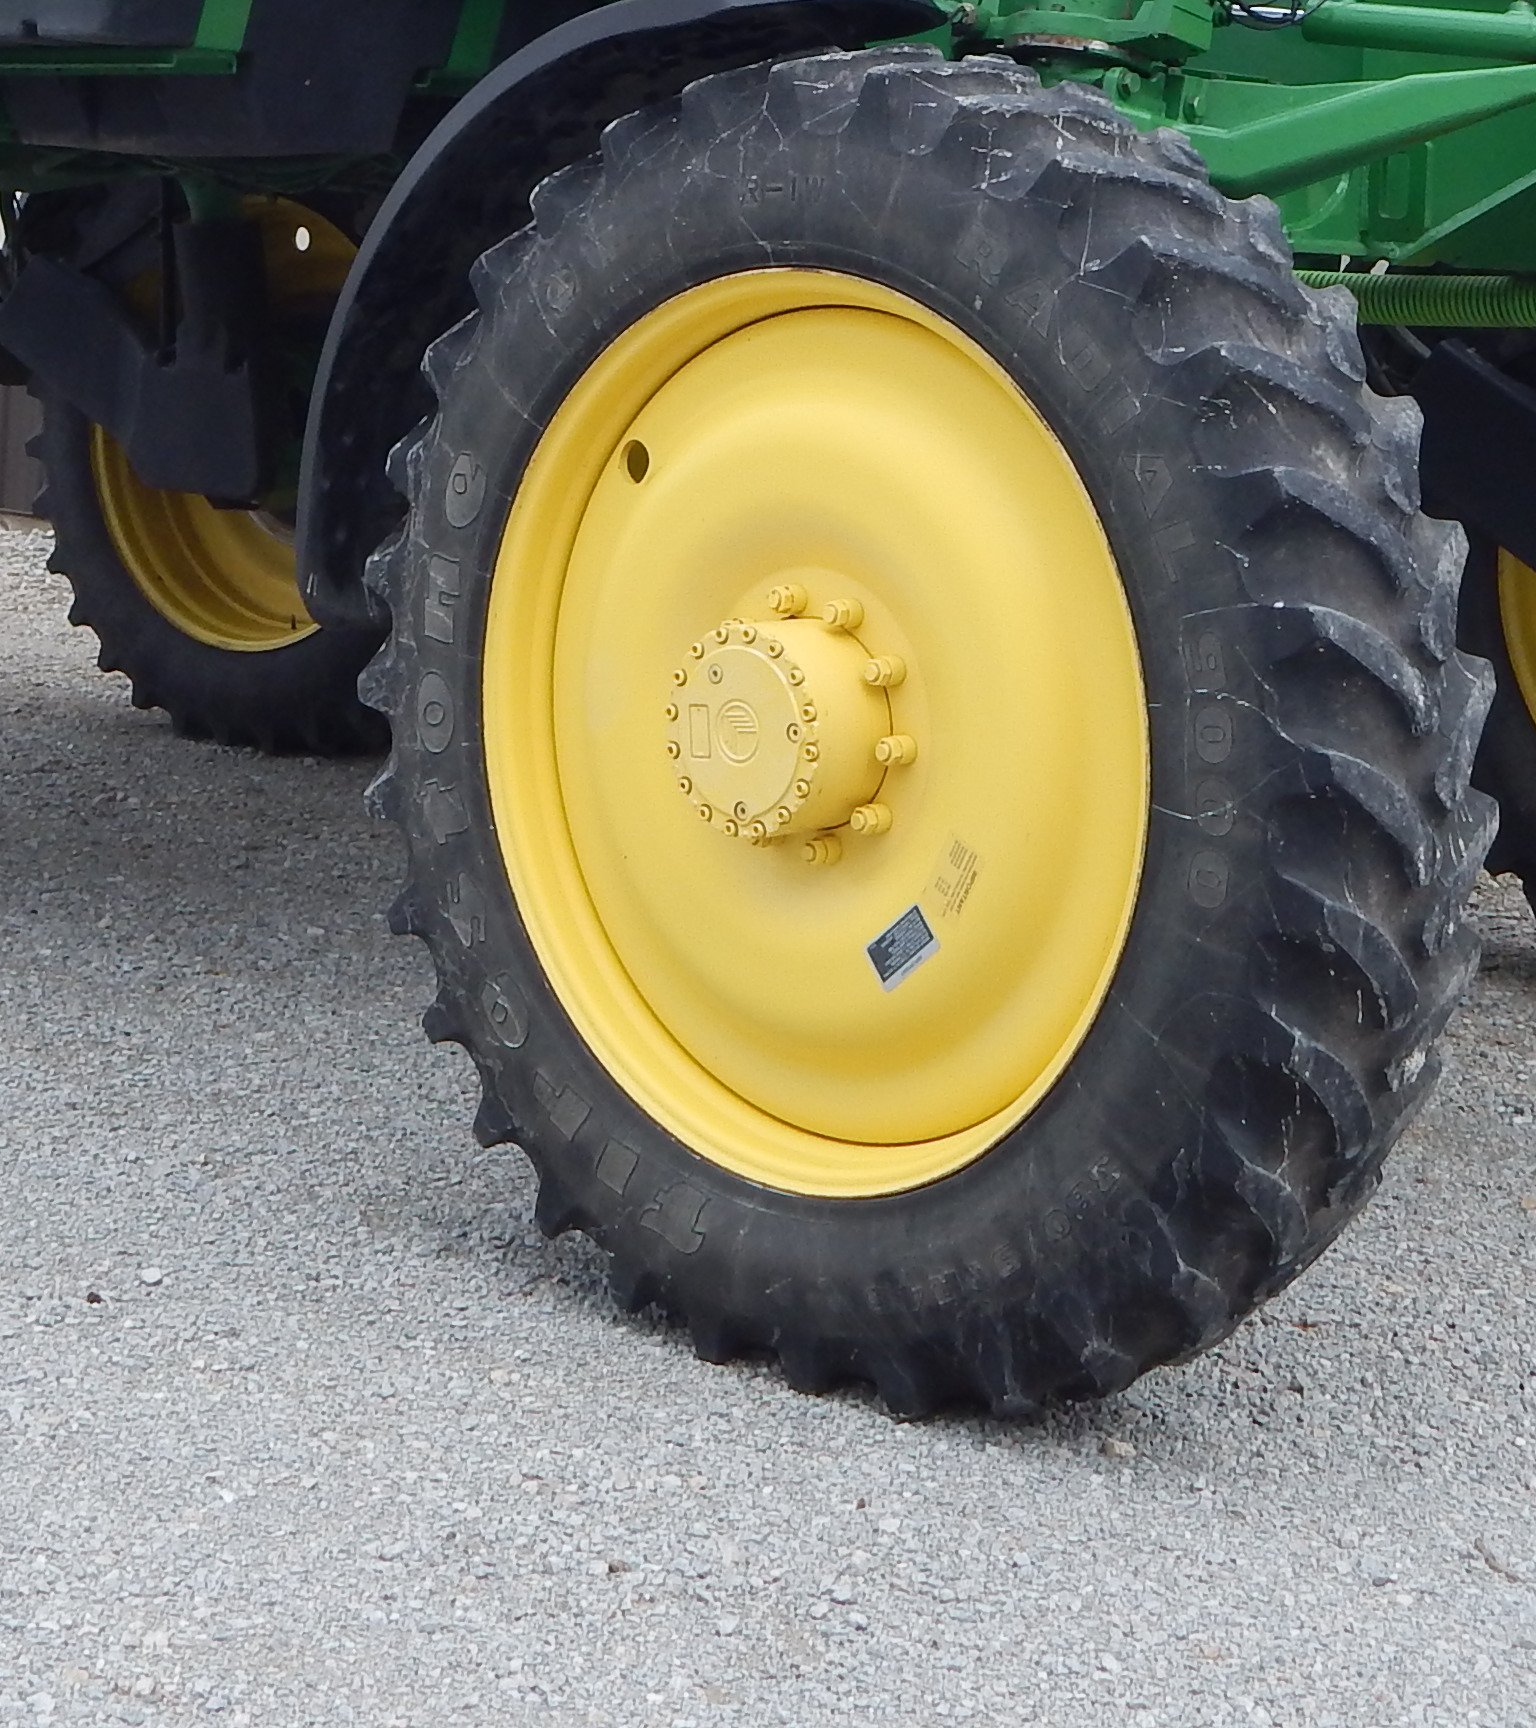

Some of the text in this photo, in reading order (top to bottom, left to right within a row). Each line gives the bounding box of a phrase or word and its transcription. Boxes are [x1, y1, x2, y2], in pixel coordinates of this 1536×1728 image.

[951, 212, 1204, 585] RADIAL
[414, 444, 713, 1259] Firestone
[1181, 627, 1235, 916] 9000
